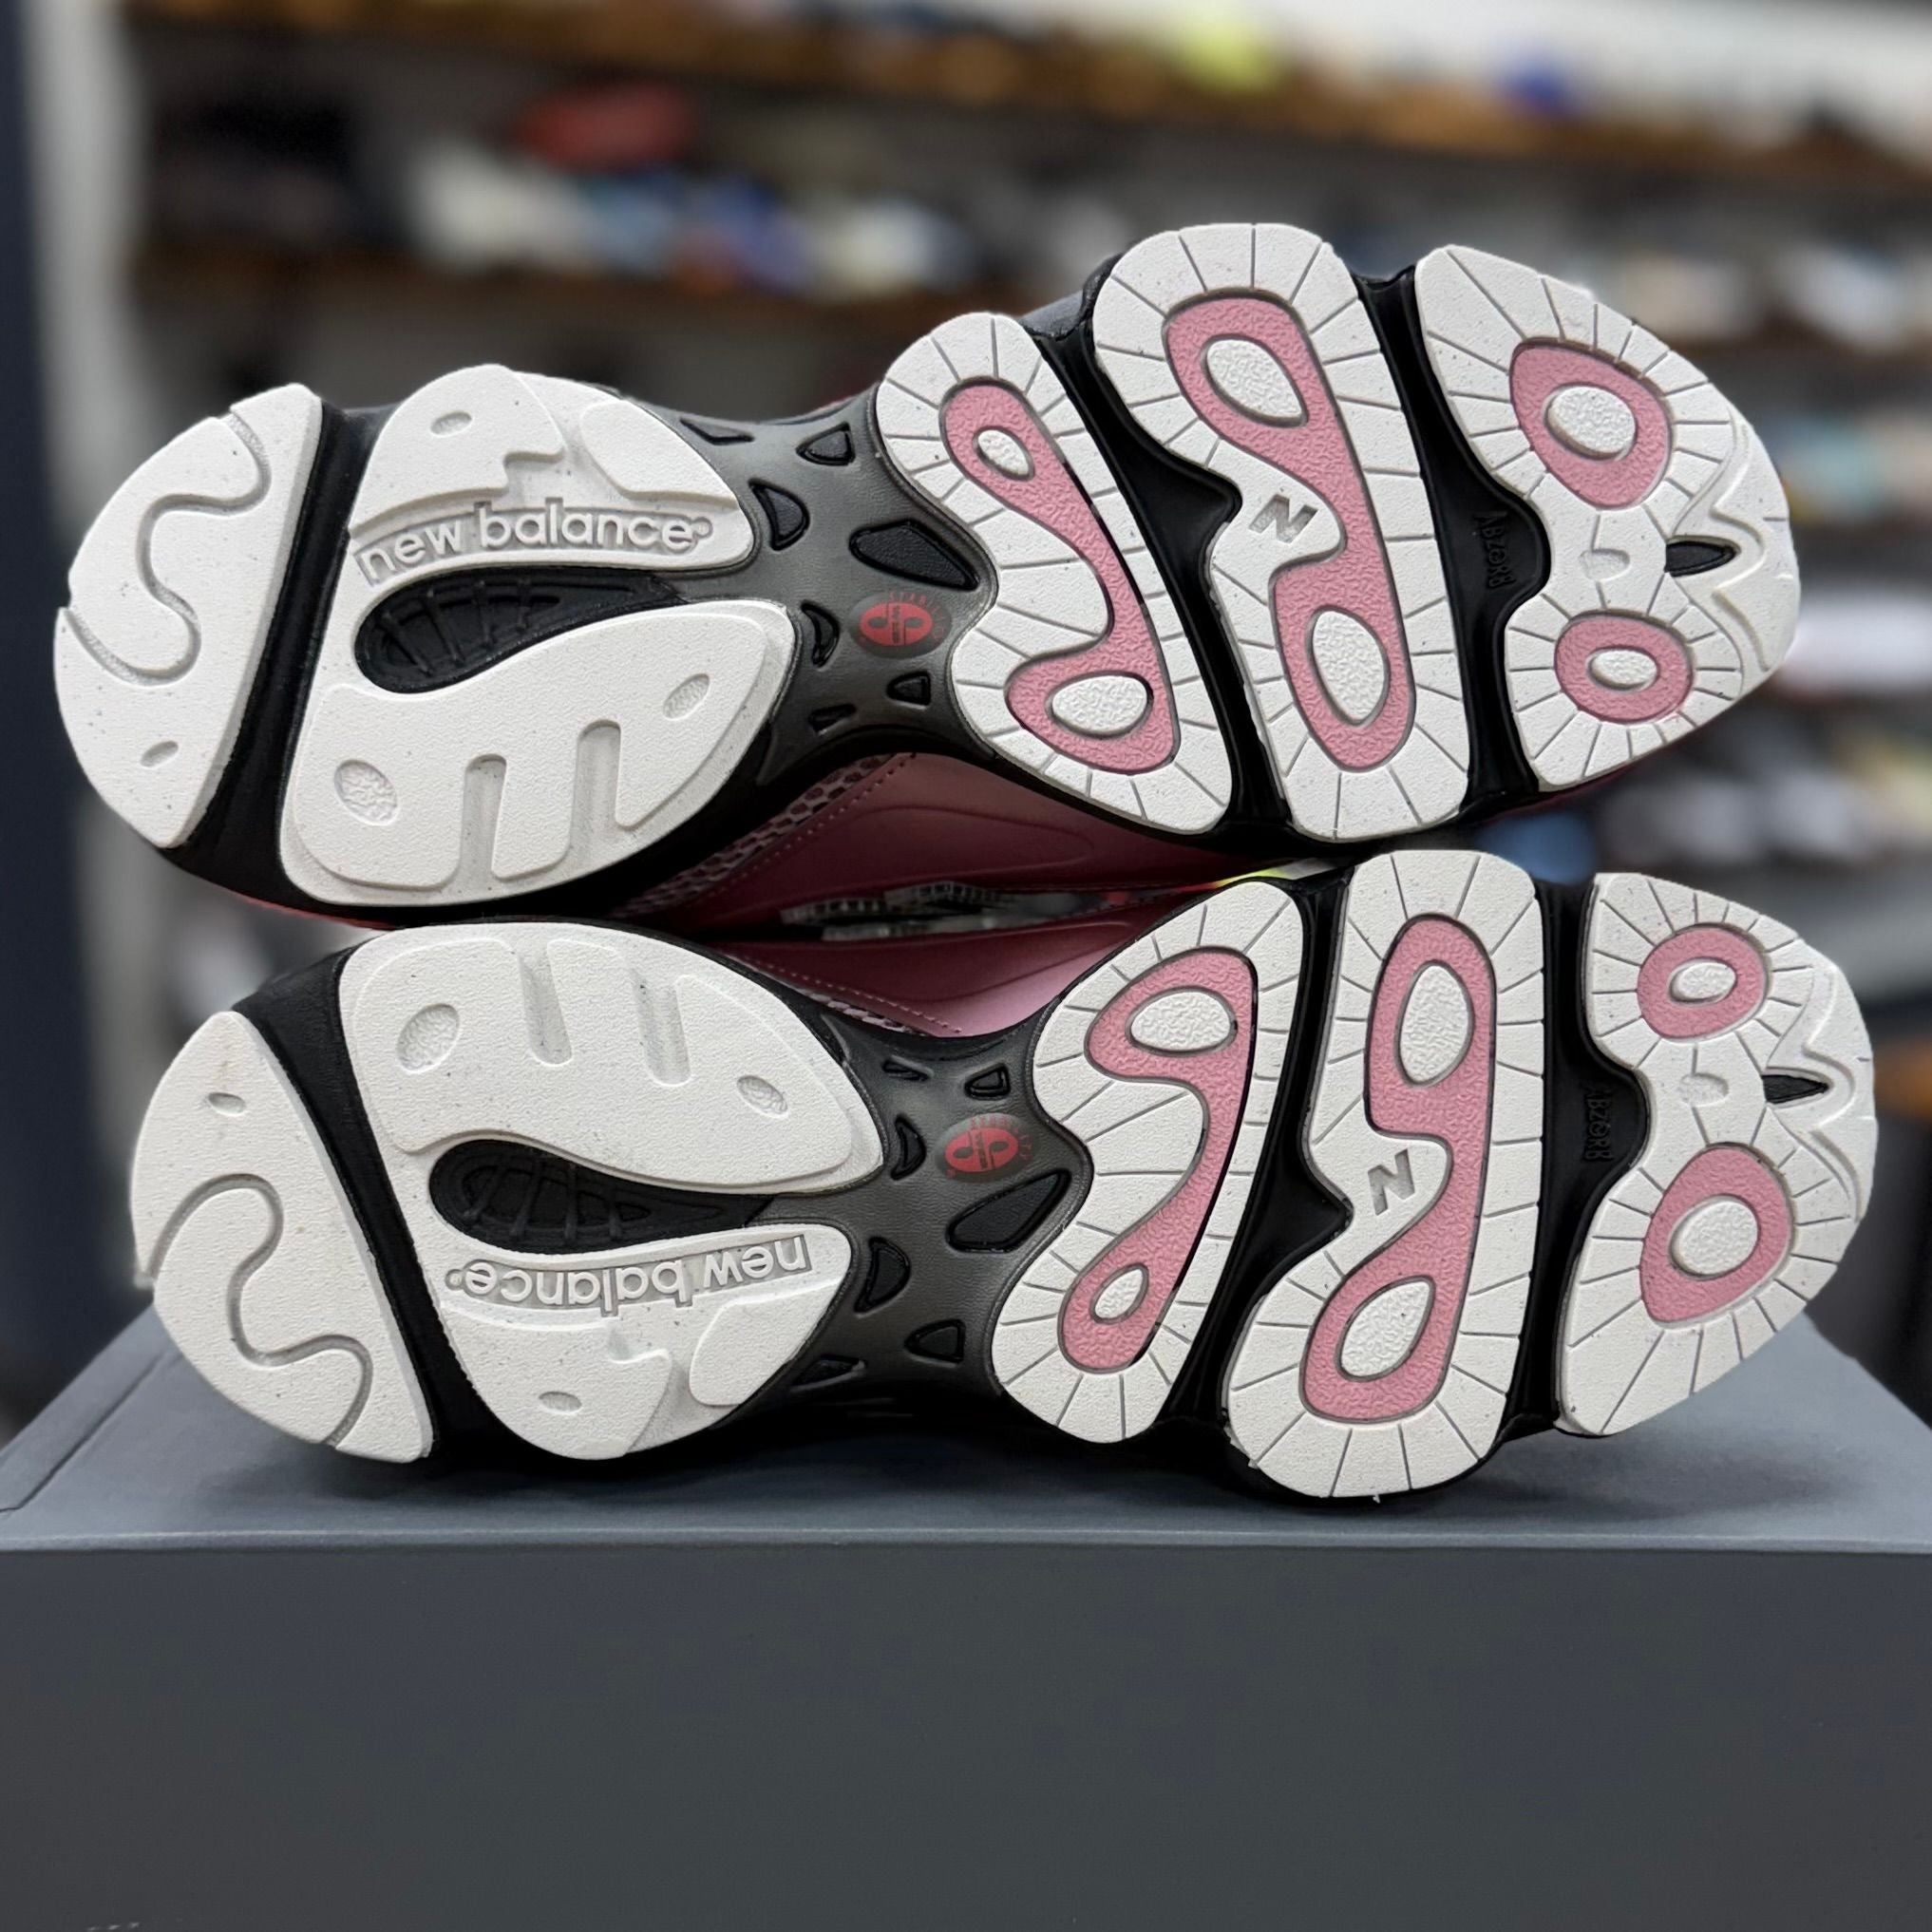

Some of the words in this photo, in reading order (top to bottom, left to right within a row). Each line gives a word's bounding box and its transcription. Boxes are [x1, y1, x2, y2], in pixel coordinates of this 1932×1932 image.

[1248, 493, 1318, 544] N
[358, 519, 463, 580] new
[1367, 1147, 1416, 1216] N
[703, 1234, 808, 1289] new
